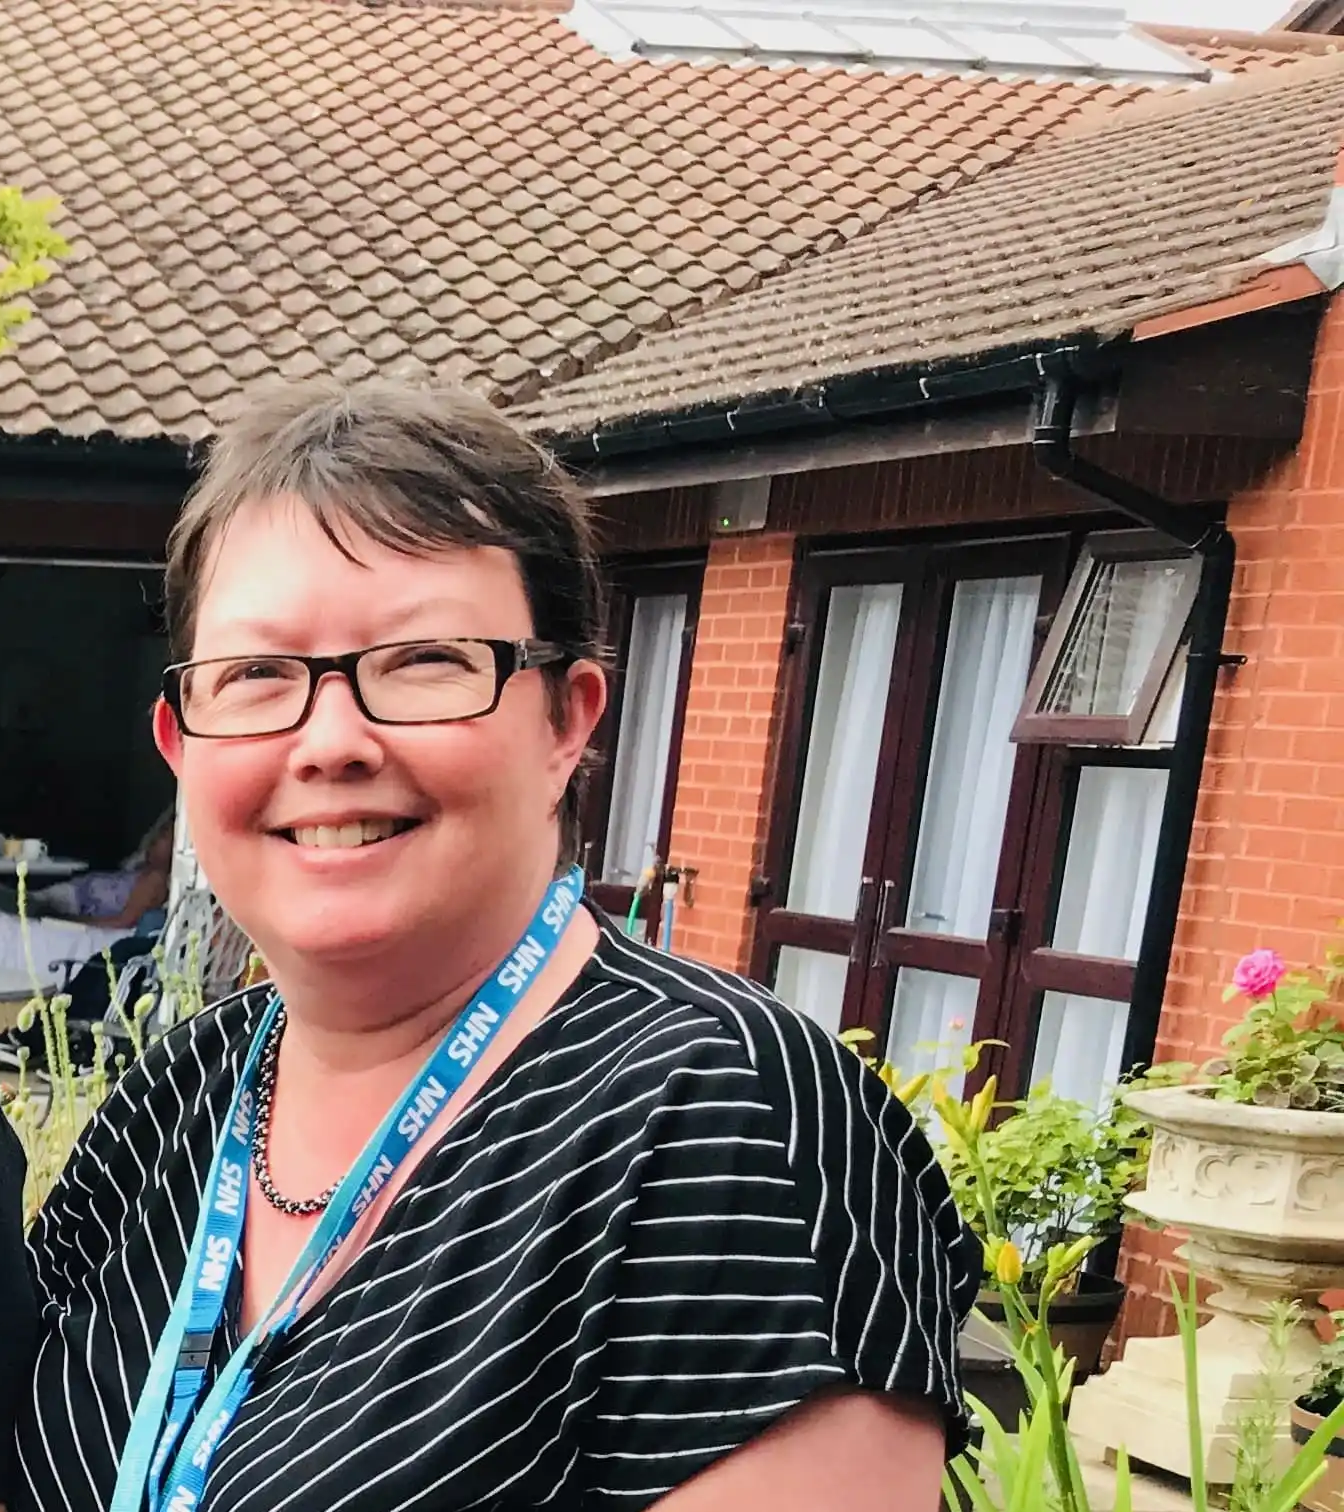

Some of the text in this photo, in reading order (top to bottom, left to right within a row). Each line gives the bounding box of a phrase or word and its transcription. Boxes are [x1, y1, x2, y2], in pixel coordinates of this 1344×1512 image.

[231, 1089, 255, 1145] NHS
[214, 1158, 243, 1216] NHS
[198, 1235, 232, 1292] NHS
